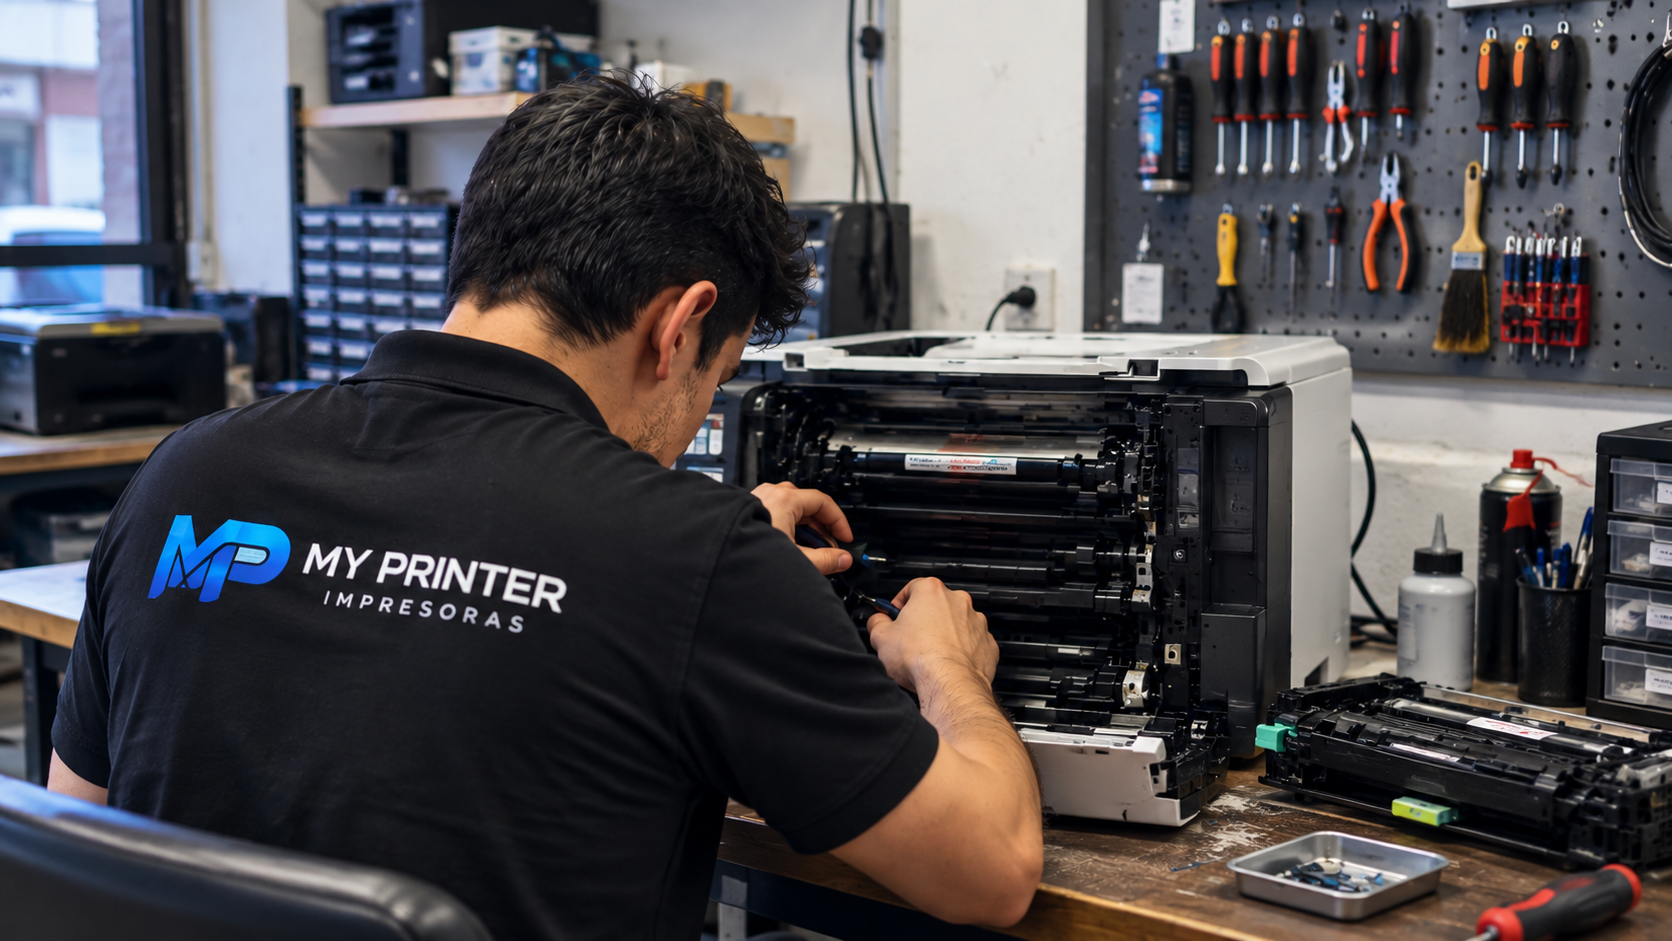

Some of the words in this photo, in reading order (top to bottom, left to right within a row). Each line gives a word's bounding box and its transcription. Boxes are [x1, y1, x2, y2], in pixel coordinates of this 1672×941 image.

[148, 514, 292, 603] MP
[302, 543, 374, 580] MY
[376, 551, 568, 614] PRINTER
[323, 590, 524, 634] IMPRESORAS
